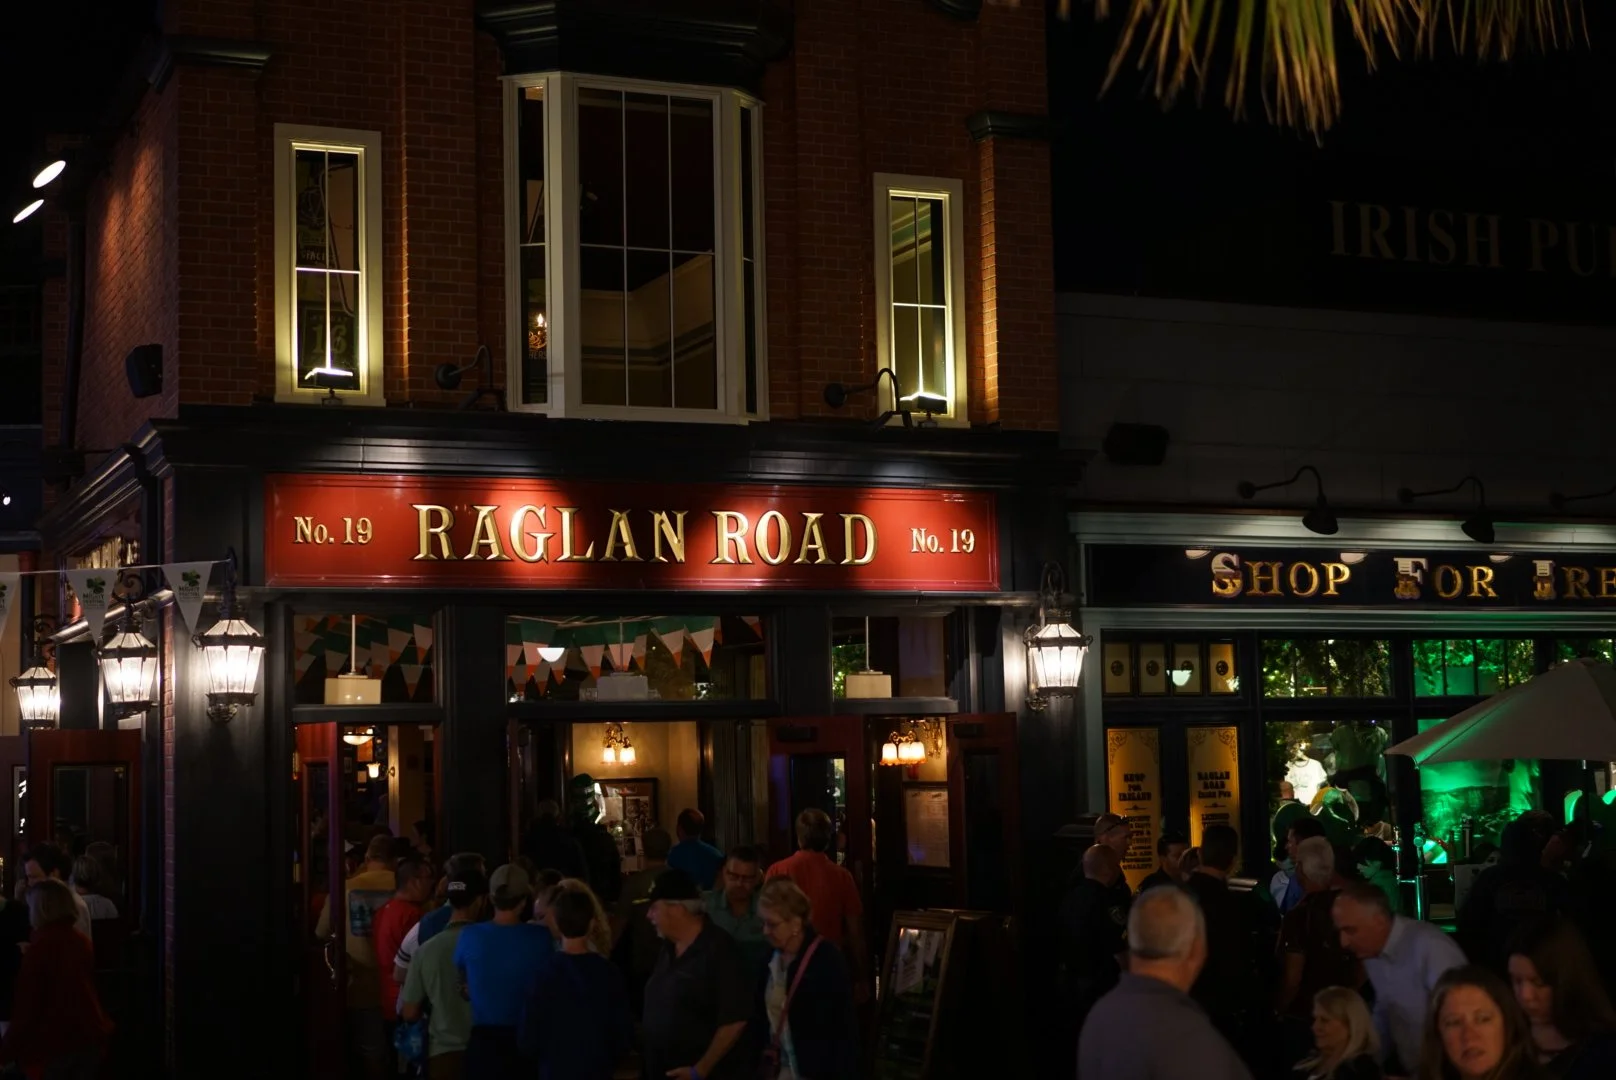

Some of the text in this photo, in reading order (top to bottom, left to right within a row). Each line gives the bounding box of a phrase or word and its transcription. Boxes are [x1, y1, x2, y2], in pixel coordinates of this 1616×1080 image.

[1327, 199, 1616, 279] IRISH PU
[293, 516, 373, 544] No. 19
[411, 504, 879, 566] RAGLAN ROAD
[911, 527, 975, 553] No. 19
[1211, 552, 1351, 599] SHOP
[1393, 556, 1499, 600] FOR
